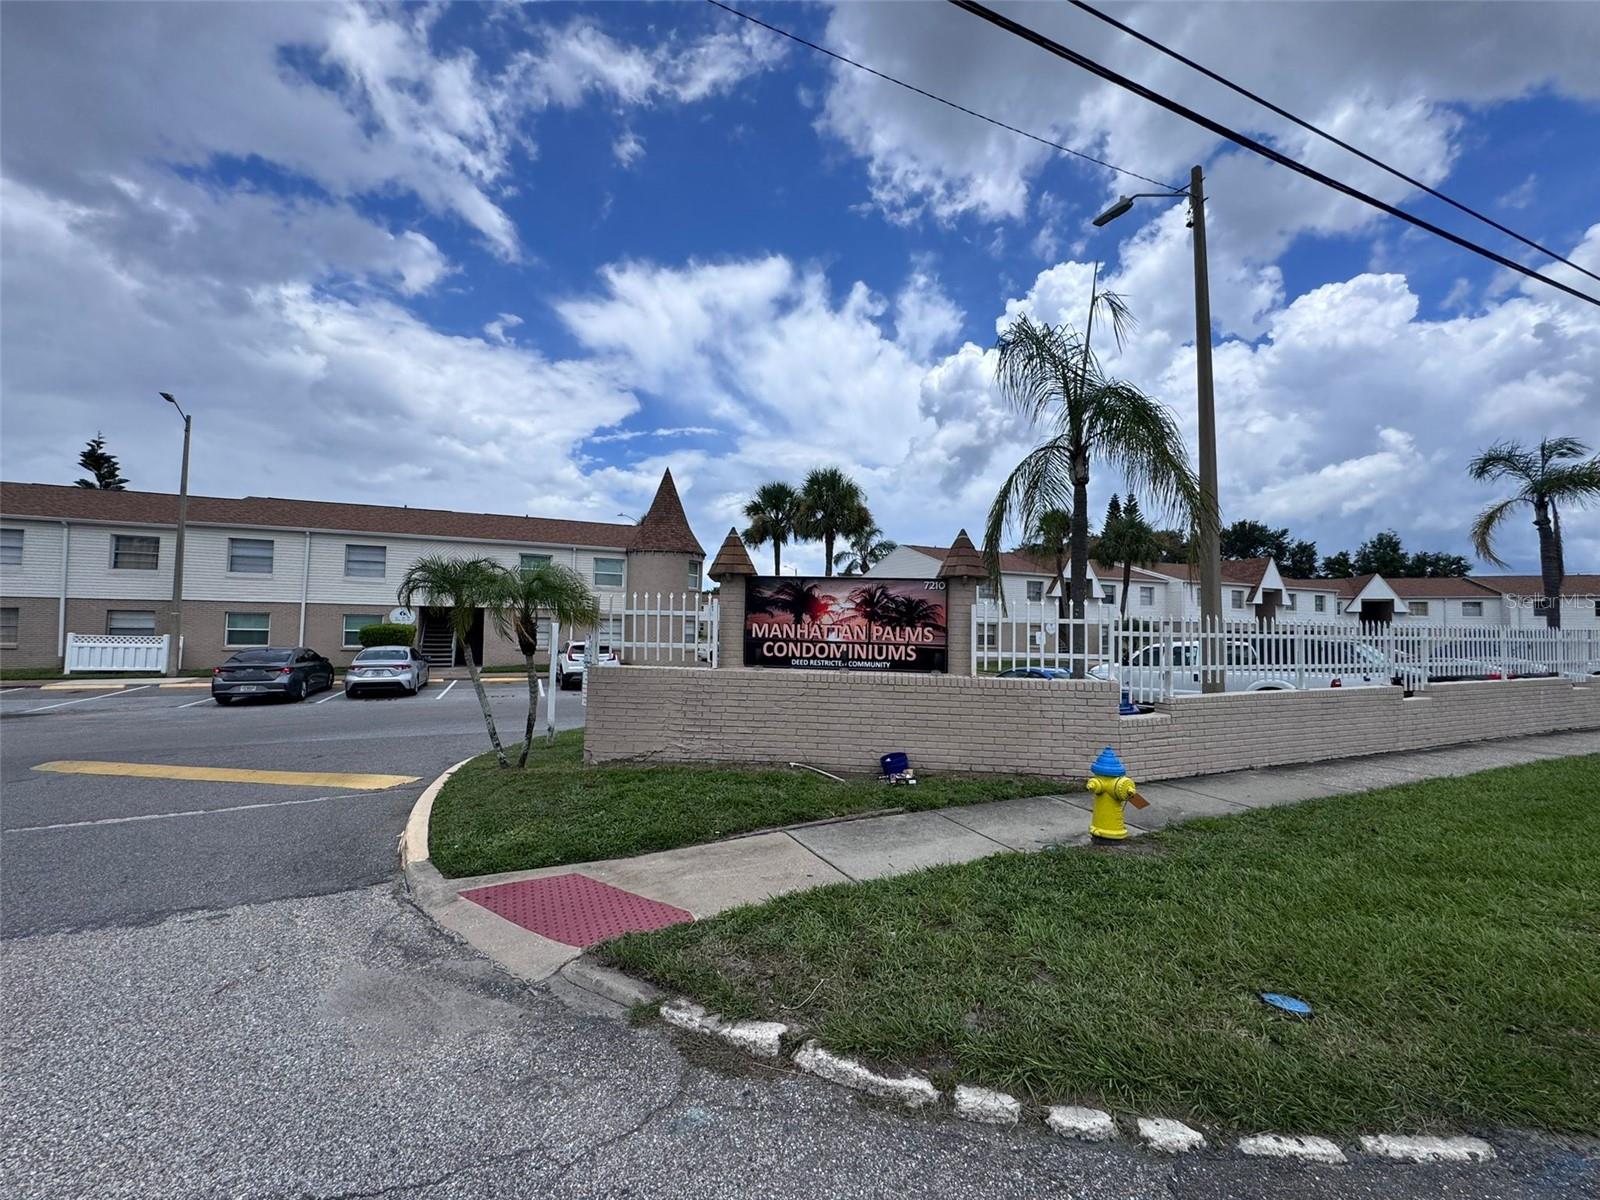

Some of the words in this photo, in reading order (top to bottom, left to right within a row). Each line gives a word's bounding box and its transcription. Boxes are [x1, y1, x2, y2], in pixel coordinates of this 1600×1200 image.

[924, 581, 946, 590] 7210
[752, 623, 867, 641] MANHATTAN
[873, 626, 934, 642] PALMS
[763, 641, 916, 661] CONDOMINIUMS
[848, 660, 890, 668] COMMUNITY
